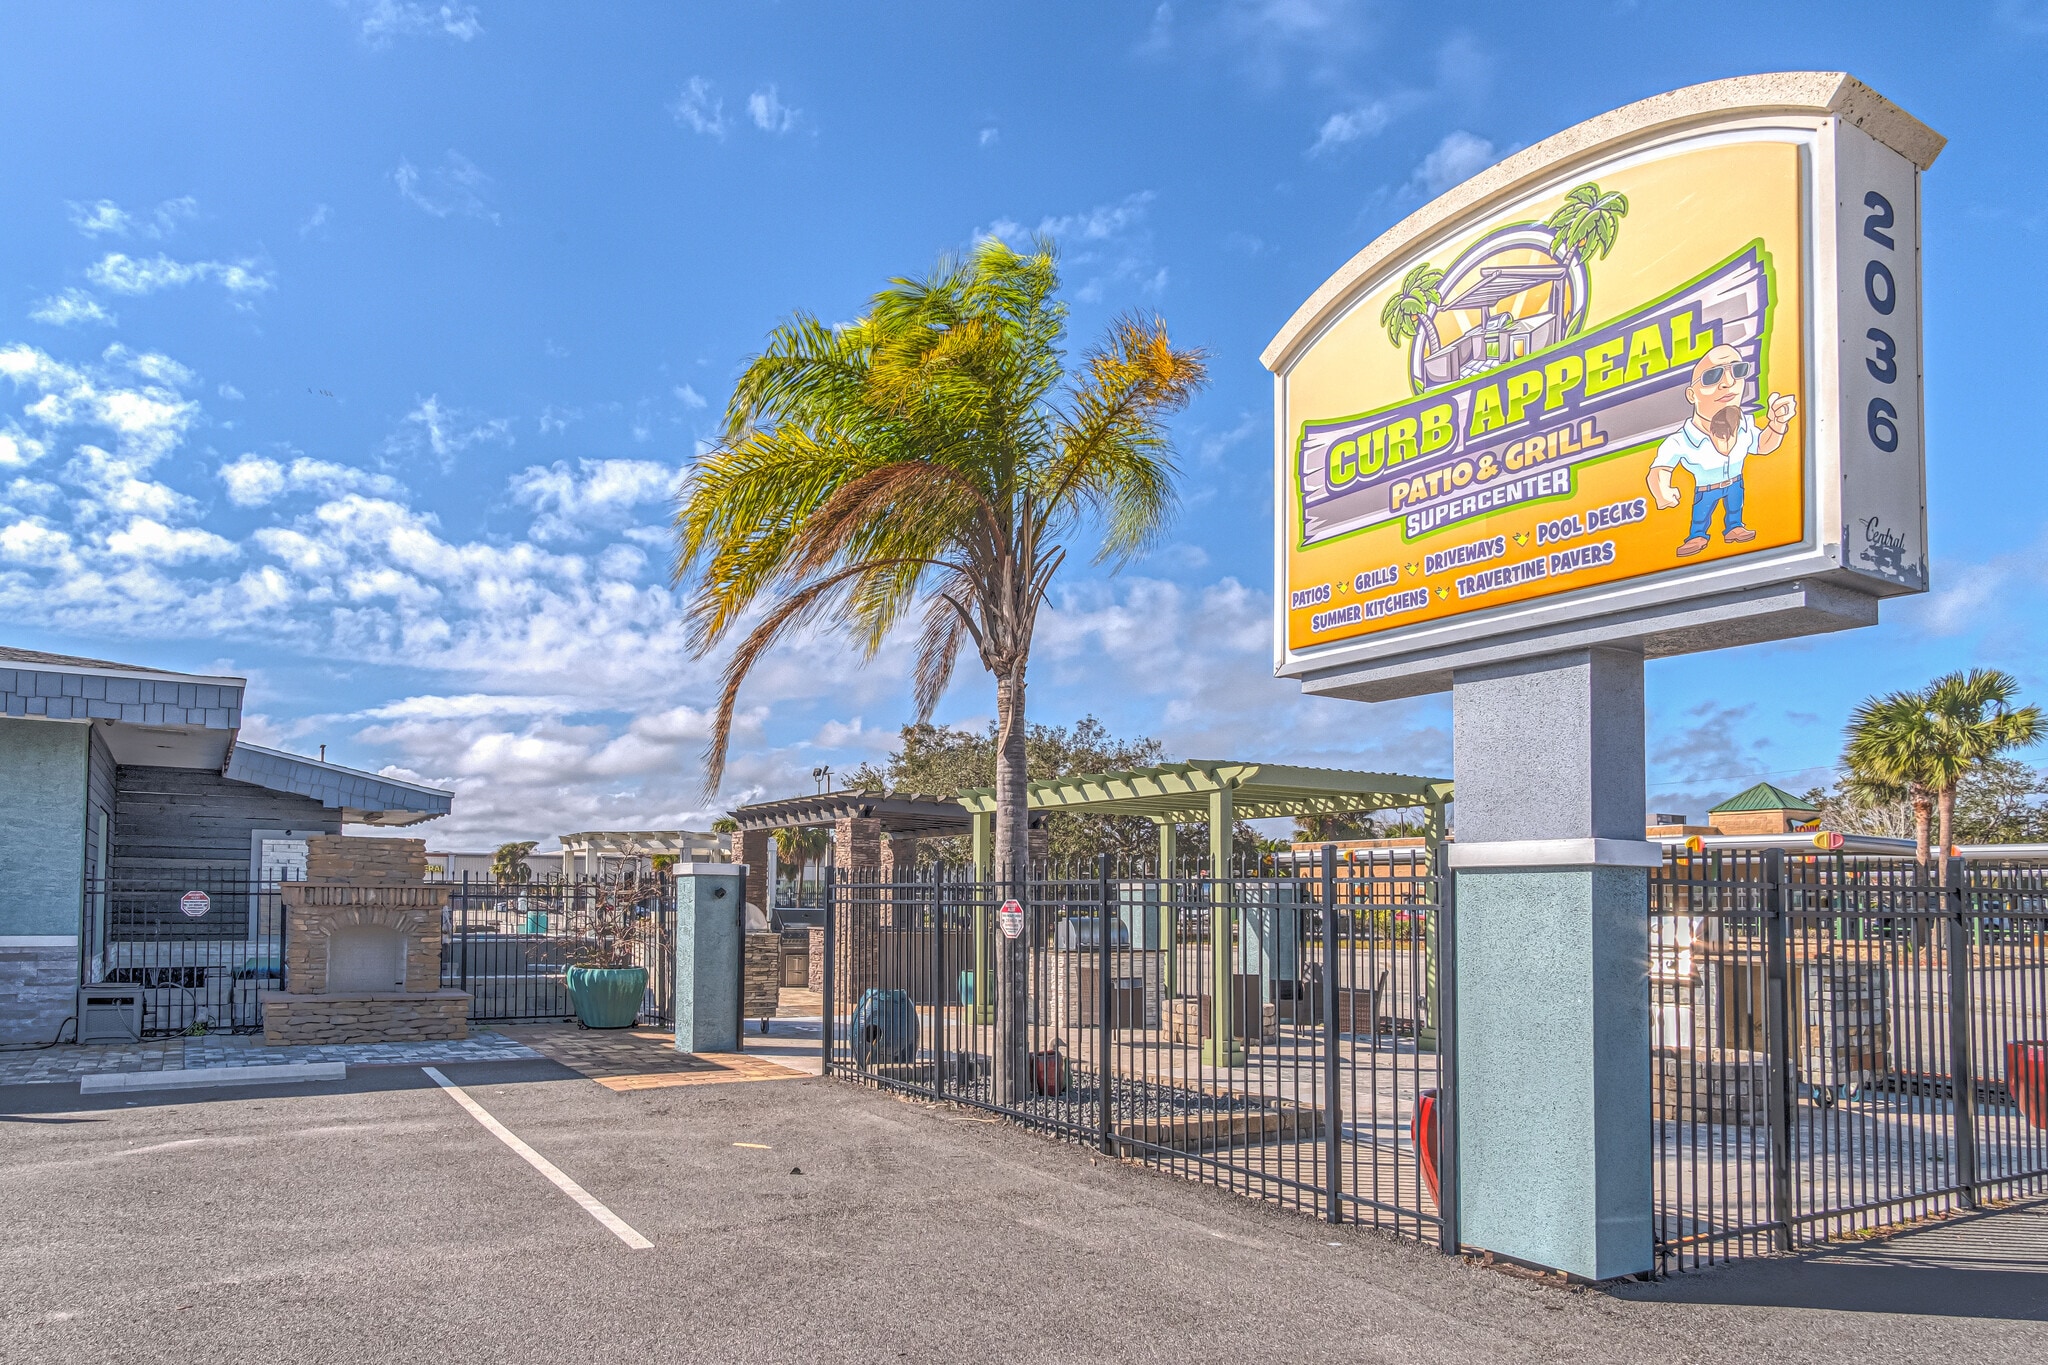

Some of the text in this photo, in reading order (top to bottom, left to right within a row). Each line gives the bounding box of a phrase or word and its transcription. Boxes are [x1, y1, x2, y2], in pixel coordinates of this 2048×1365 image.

[1863, 190, 1899, 453] 2036
[1328, 310, 1718, 486] CURB APPEAL
[1391, 420, 1605, 510] PATIO & GRILL
[1407, 468, 1570, 538] SUPERCENTER
[1291, 499, 1646, 608] PATIOS GRILLS DRIVEWAYS POOL DECKS
[1860, 516, 1906, 549] Central
[1311, 542, 1615, 631] SUMMER KITCHENS TRAVERTINE PAVERS
